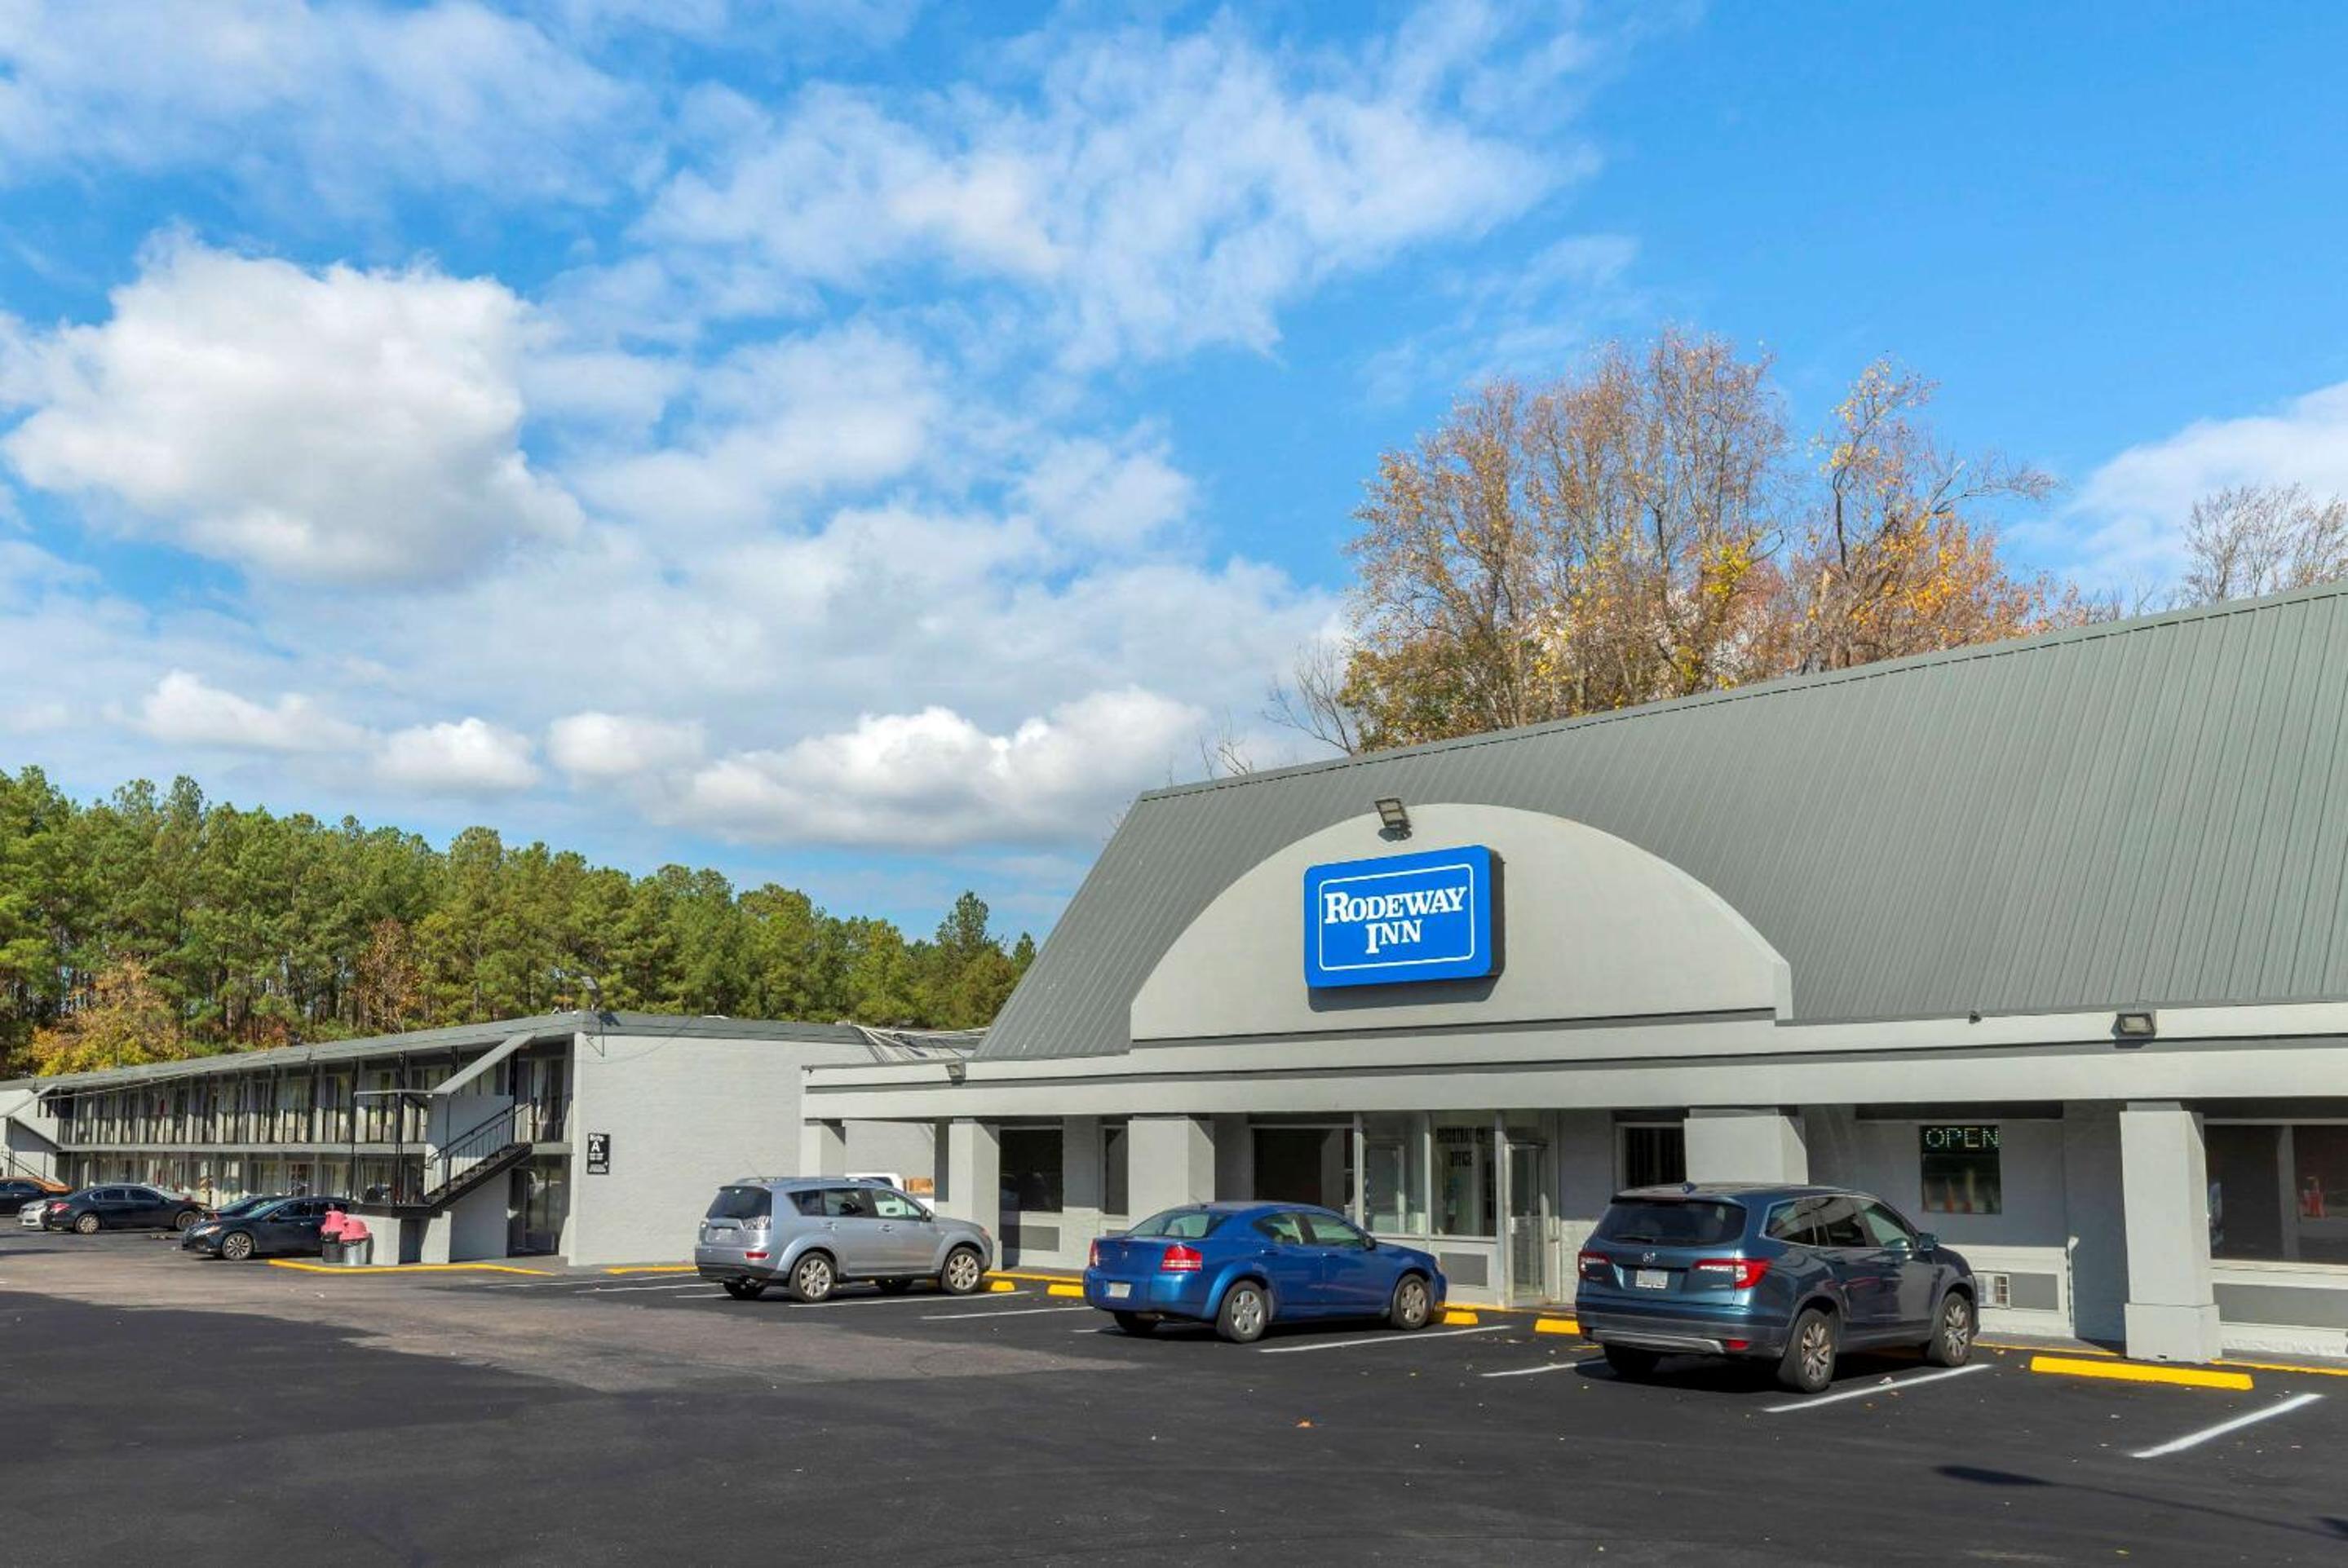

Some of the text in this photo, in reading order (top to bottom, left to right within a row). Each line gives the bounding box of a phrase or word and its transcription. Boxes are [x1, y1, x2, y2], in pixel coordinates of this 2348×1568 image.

[1324, 886, 1467, 925] RODEWAY
[1365, 920, 1422, 954] INN
[591, 1141, 600, 1152] A
[1926, 1127, 2002, 1149] OPEN
